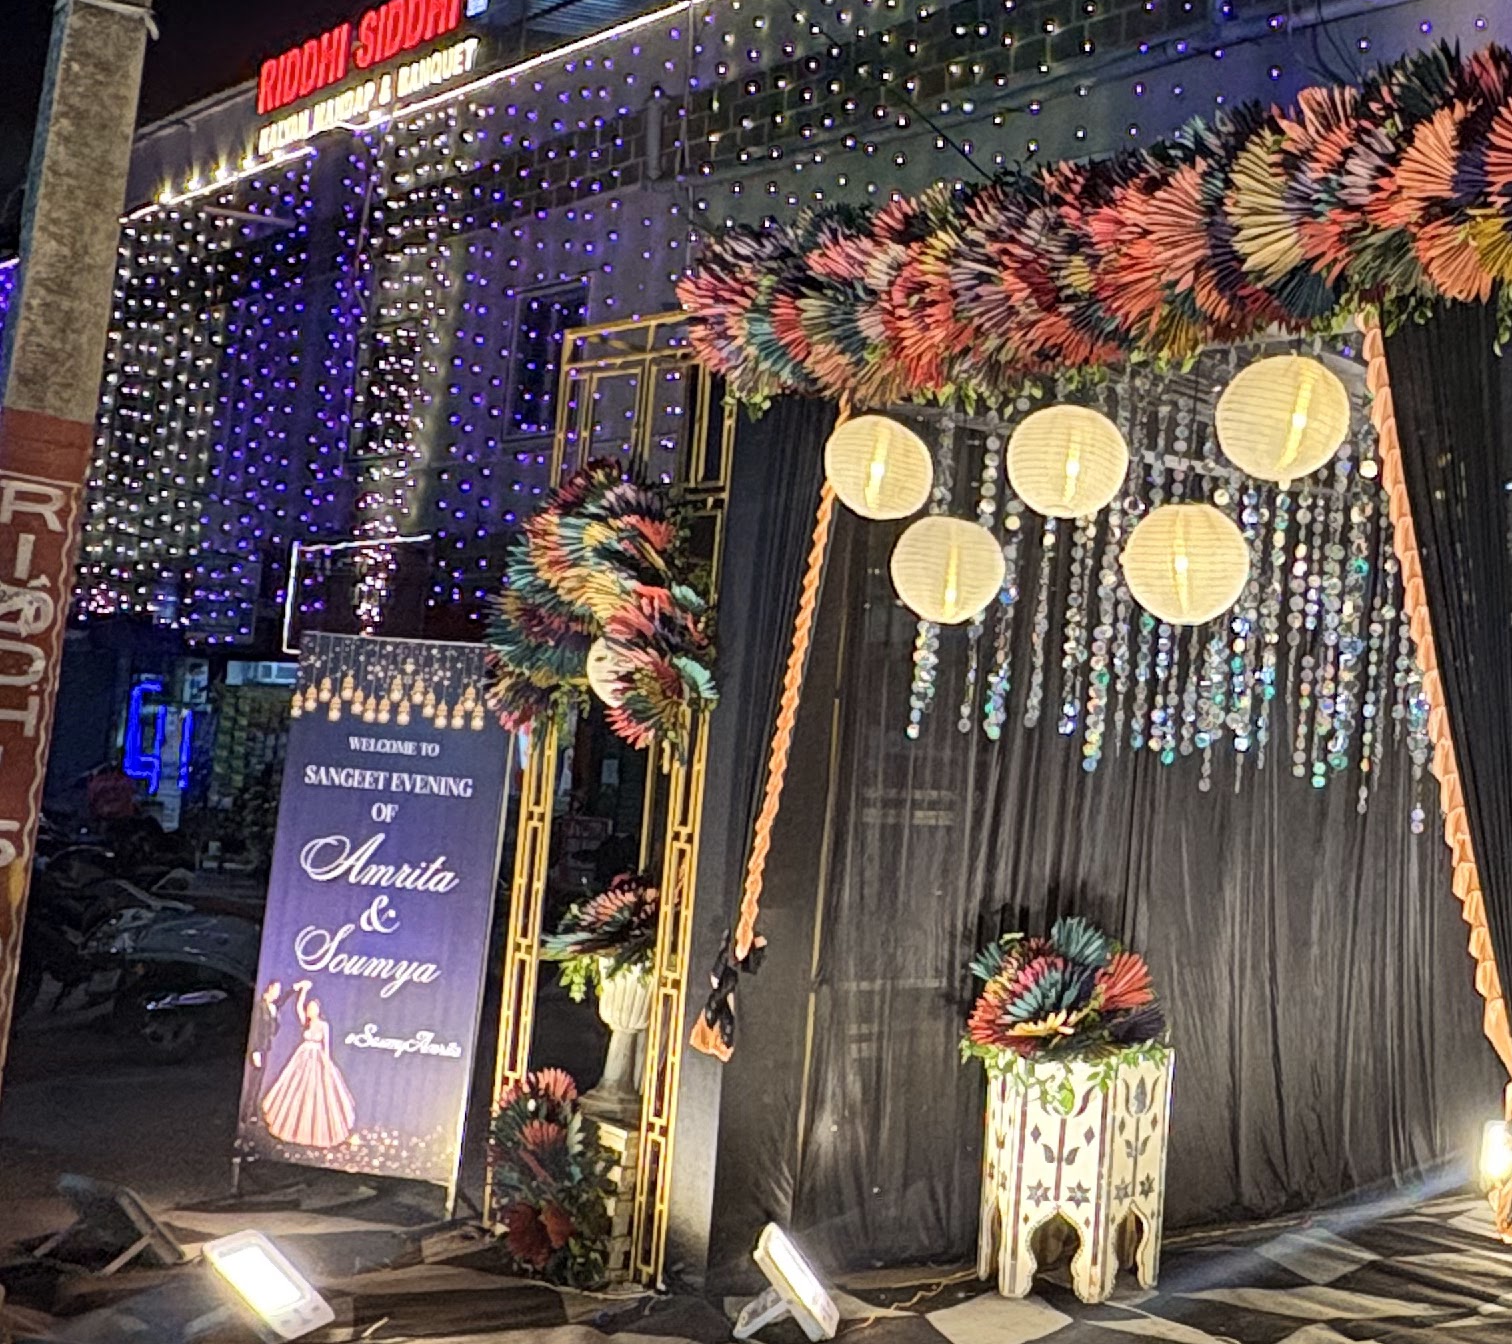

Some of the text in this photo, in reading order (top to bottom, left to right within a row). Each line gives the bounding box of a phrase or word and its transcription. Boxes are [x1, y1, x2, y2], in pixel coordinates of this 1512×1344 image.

[257, 22, 351, 115] RIDDHI
[348, 736, 440, 758] WELCOME TO
[304, 764, 473, 799] SANGEET EVENING
[371, 801, 400, 823] OF
[300, 832, 460, 895] Amrita
[360, 895, 400, 934] &
[294, 923, 442, 998] Soumya
